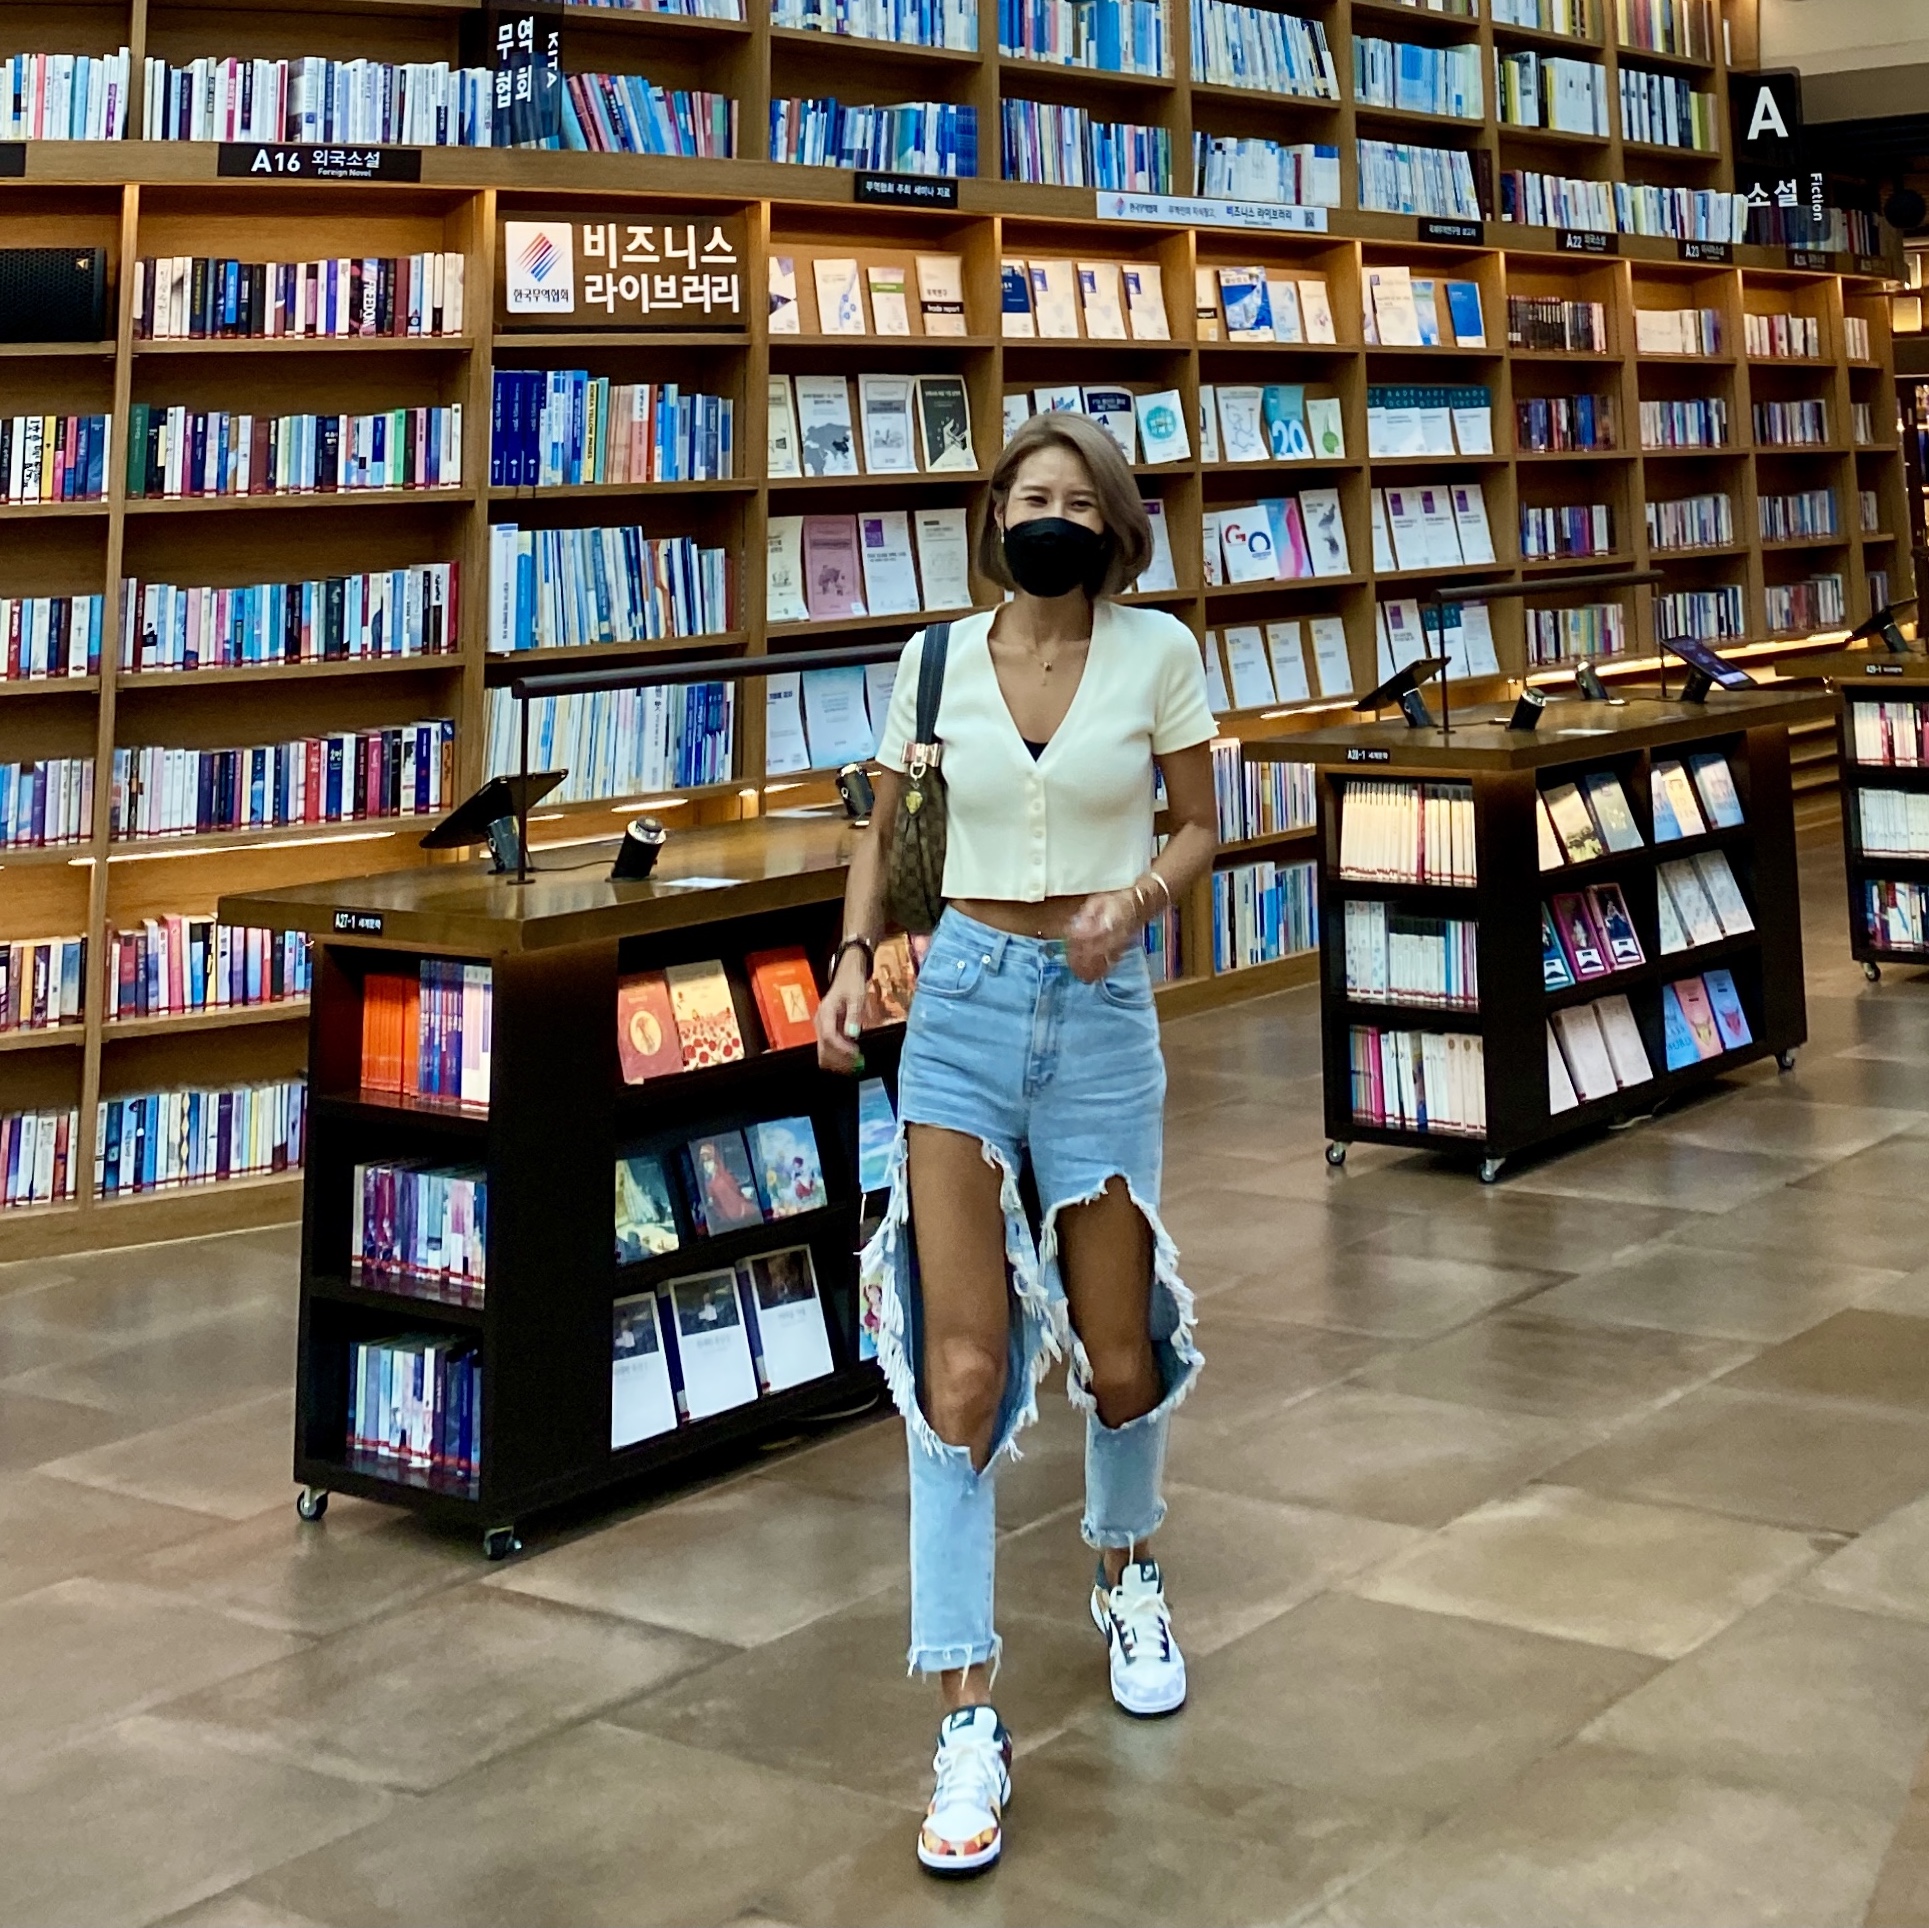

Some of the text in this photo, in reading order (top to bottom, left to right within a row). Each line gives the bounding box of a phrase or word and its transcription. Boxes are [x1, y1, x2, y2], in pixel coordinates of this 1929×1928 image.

[496, 16, 534, 60] 무역
[546, 31, 559, 89] KITA
[495, 64, 533, 109] 협회
[1747, 86, 1789, 140] A
[250, 149, 301, 173] A16
[311, 150, 381, 169] 외국소설
[317, 167, 373, 178] Foreign Novel
[1747, 178, 1799, 208] 소설
[1810, 172, 1825, 222] Fiction
[1226, 205, 1255, 218] 비즈니스
[1257, 207, 1293, 221] 라이브러리
[582, 223, 738, 270] 비즈니스
[1566, 232, 1583, 249] A22
[1685, 243, 1700, 258] A23
[363, 278, 376, 328] FREEDOM
[512, 287, 570, 303] 한국무역협회
[584, 272, 740, 314] 라이브러리
[1271, 420, 1305, 454] 20
[335, 912, 356, 930] A27-1
